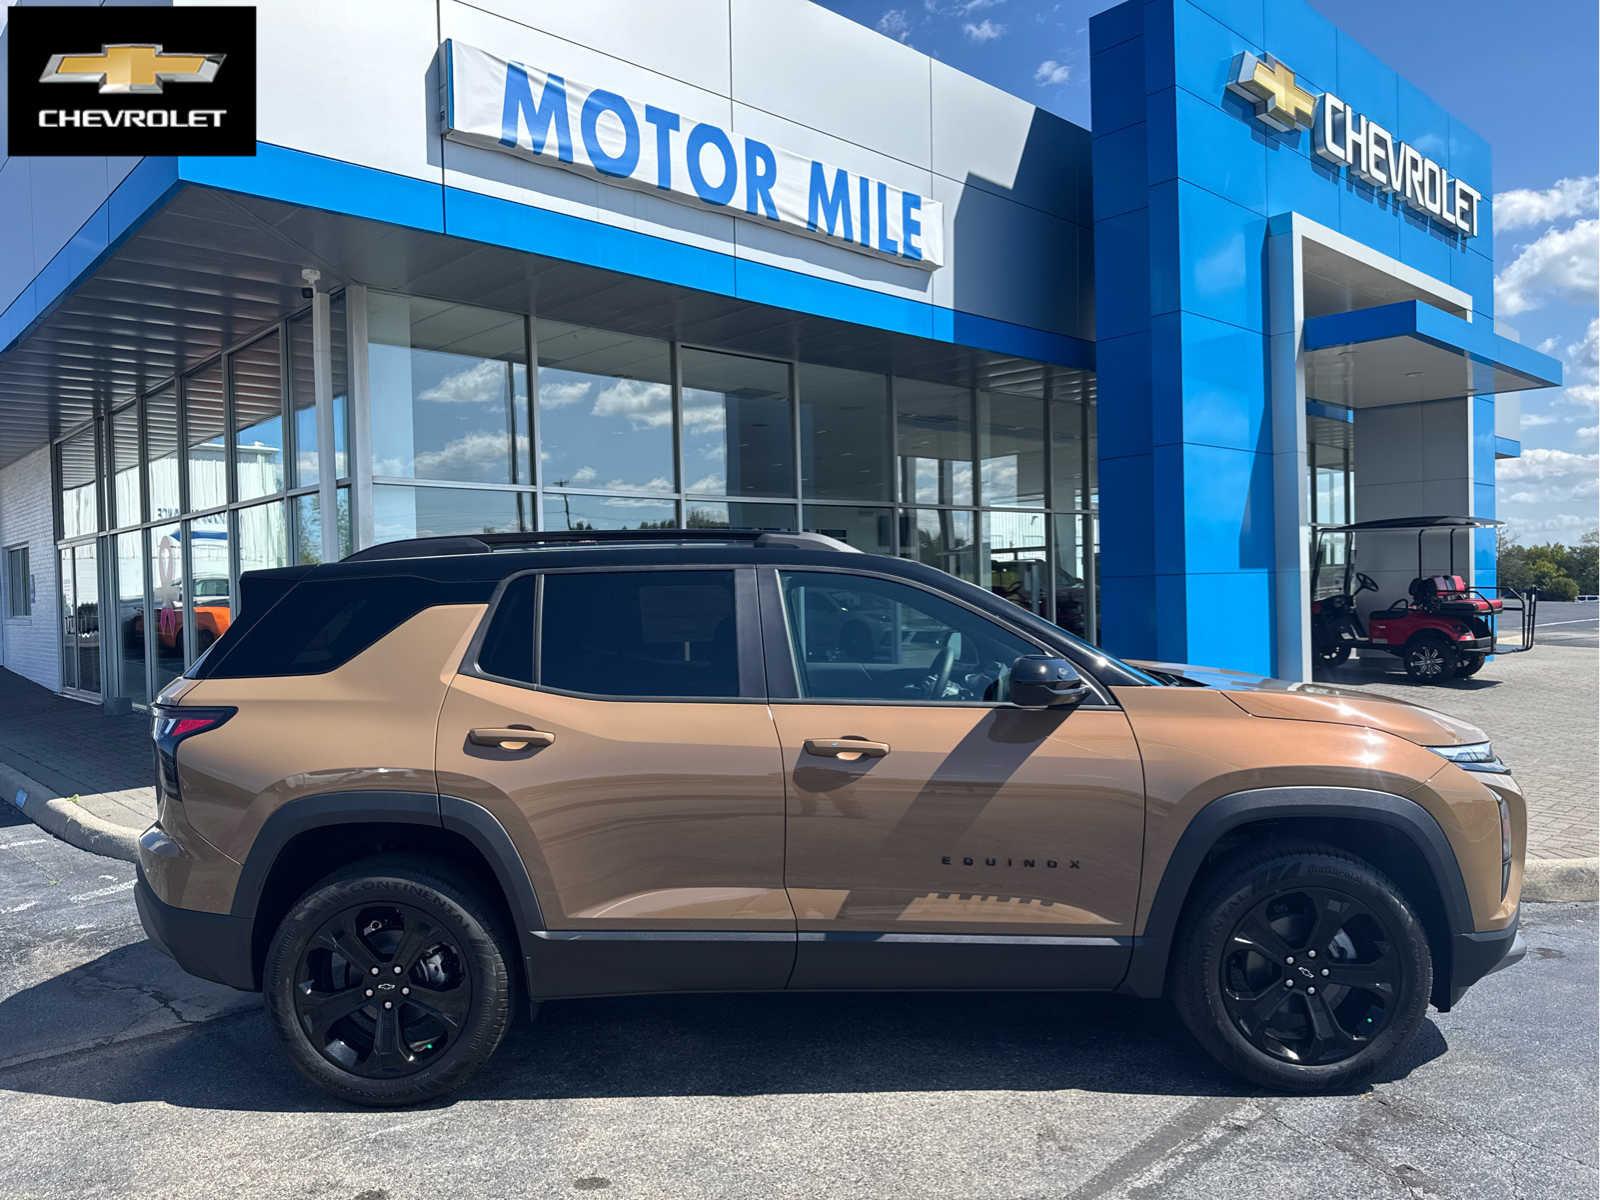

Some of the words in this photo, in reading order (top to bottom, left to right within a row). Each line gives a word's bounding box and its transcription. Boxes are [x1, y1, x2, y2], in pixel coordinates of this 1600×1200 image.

[499, 61, 781, 222] MOTOR
[806, 160, 922, 261] MILE
[1322, 91, 1482, 238] CHEVROLET
[349, 880, 471, 930] CONTINENTAL
[941, 855, 1081, 870] EQUINOX
